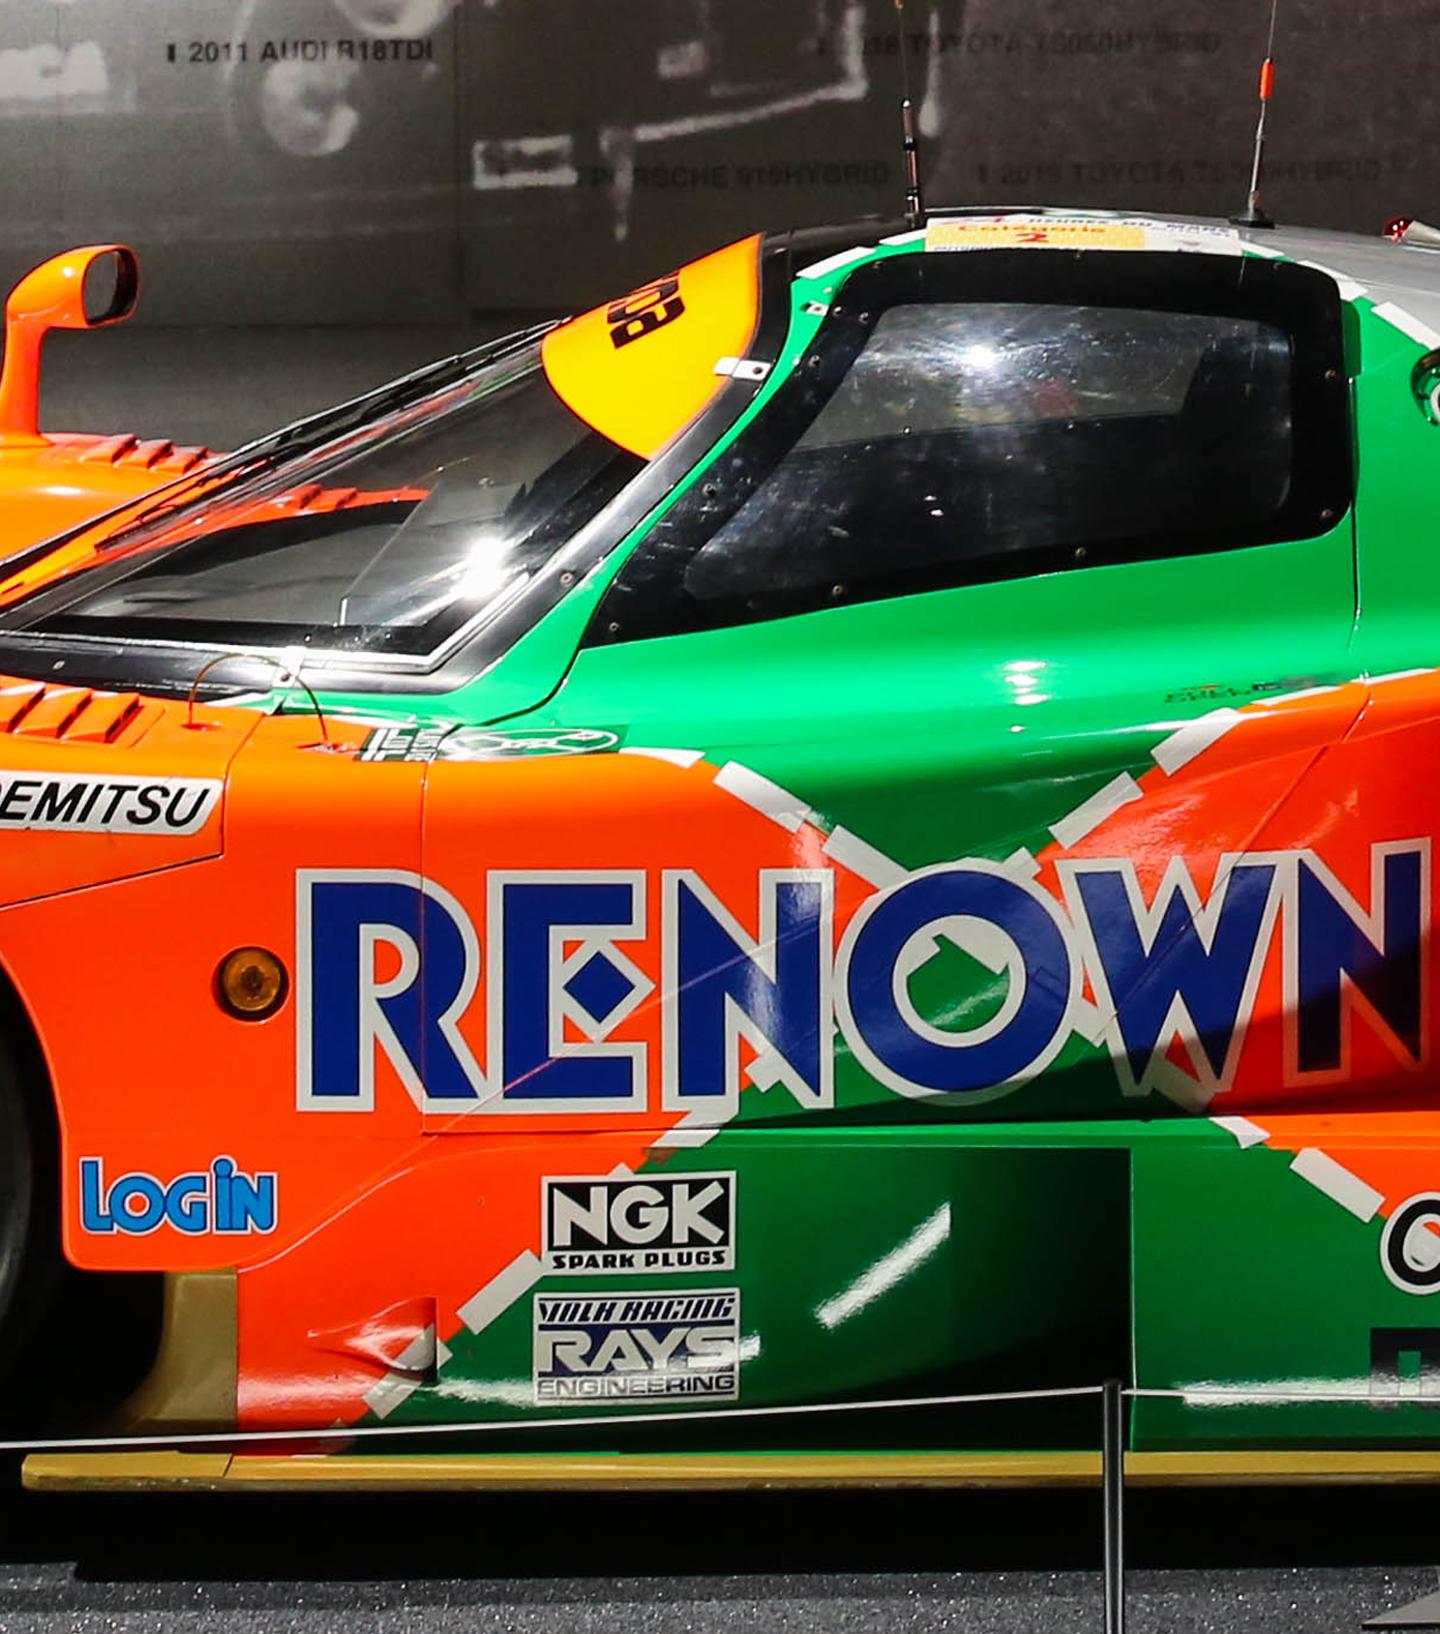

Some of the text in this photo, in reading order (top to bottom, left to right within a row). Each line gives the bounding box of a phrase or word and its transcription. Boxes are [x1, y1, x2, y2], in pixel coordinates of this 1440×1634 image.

[188, 41, 249, 63] 2011
[260, 40, 327, 62] AUDI
[590, 166, 728, 190] PRSCHE
[295, 837, 1434, 1114] RENOWN
[551, 1179, 725, 1247] NGK
[551, 1250, 727, 1270] SPARK PLUGS
[539, 1297, 735, 1322] VOLK RACING
[537, 1326, 735, 1372] RAYS
[537, 1374, 735, 1399] ENGINEERING
